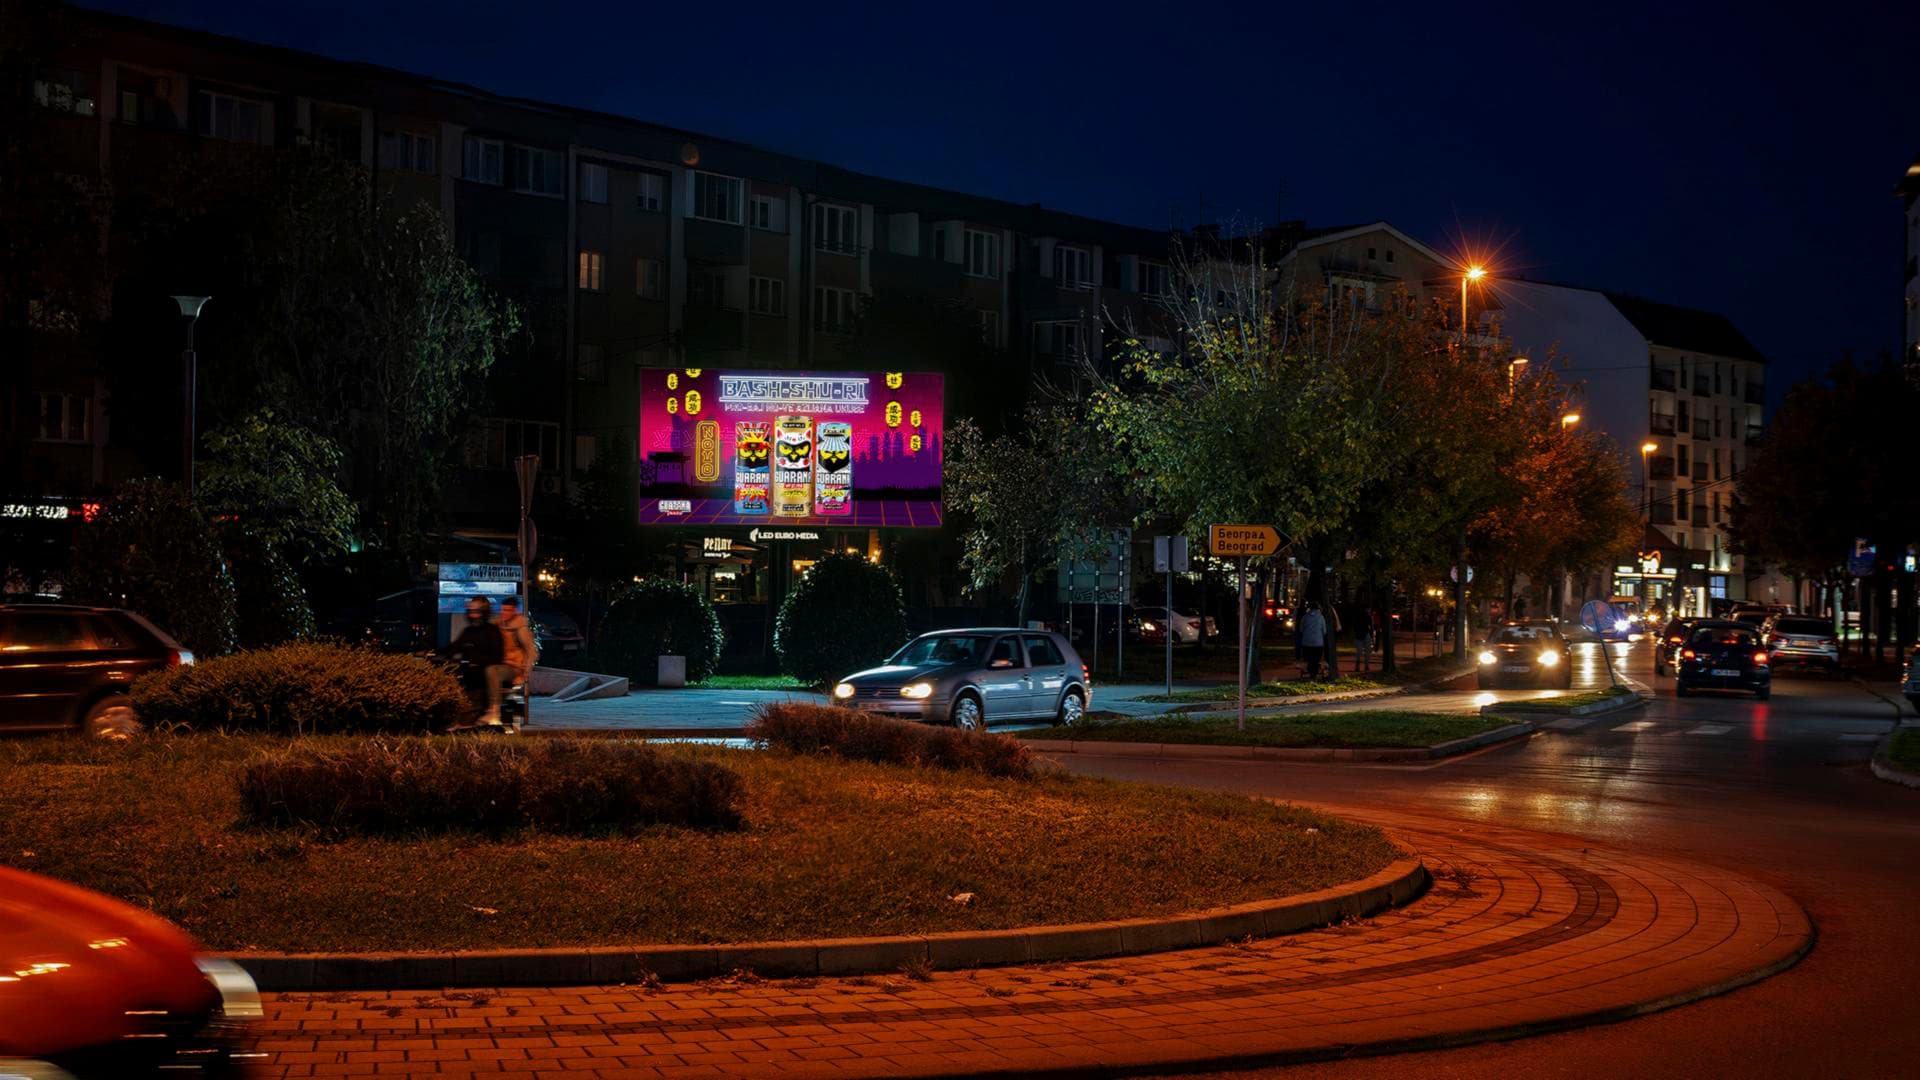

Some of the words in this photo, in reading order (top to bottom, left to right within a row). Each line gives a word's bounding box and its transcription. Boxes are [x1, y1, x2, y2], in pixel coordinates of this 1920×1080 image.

[722, 381, 866, 400] BASH-SHU-RI
[774, 532, 796, 540] EURO
[1218, 528, 1265, 541] Београд
[1218, 540, 1264, 554] Beograd
